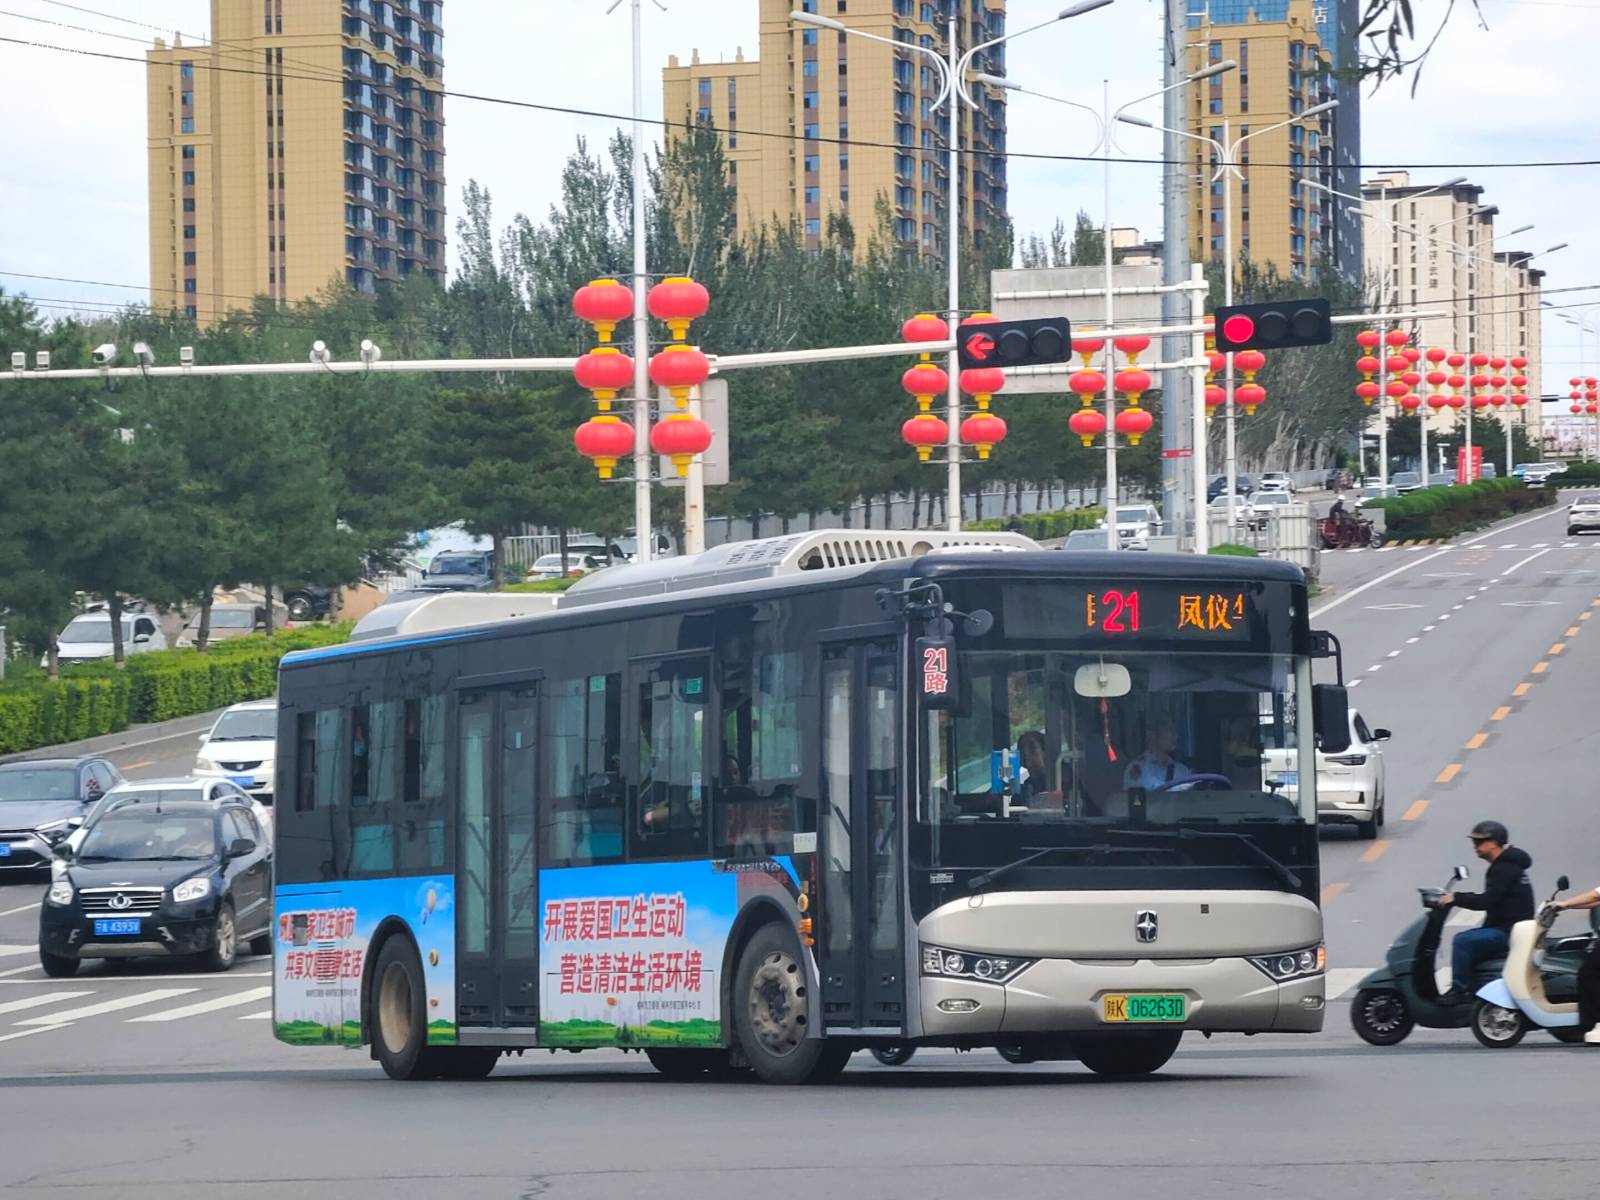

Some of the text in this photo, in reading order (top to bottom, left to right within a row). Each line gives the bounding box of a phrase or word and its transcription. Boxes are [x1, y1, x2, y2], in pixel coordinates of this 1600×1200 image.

[1312, 0, 1328, 24] 店
[1102, 591, 1139, 632] 21
[924, 648, 947, 672] 21
[924, 672, 948, 694] 路
[544, 893, 686, 942] 开展爱国卫生运动
[559, 950, 702, 995] 营造清洁生活环境
